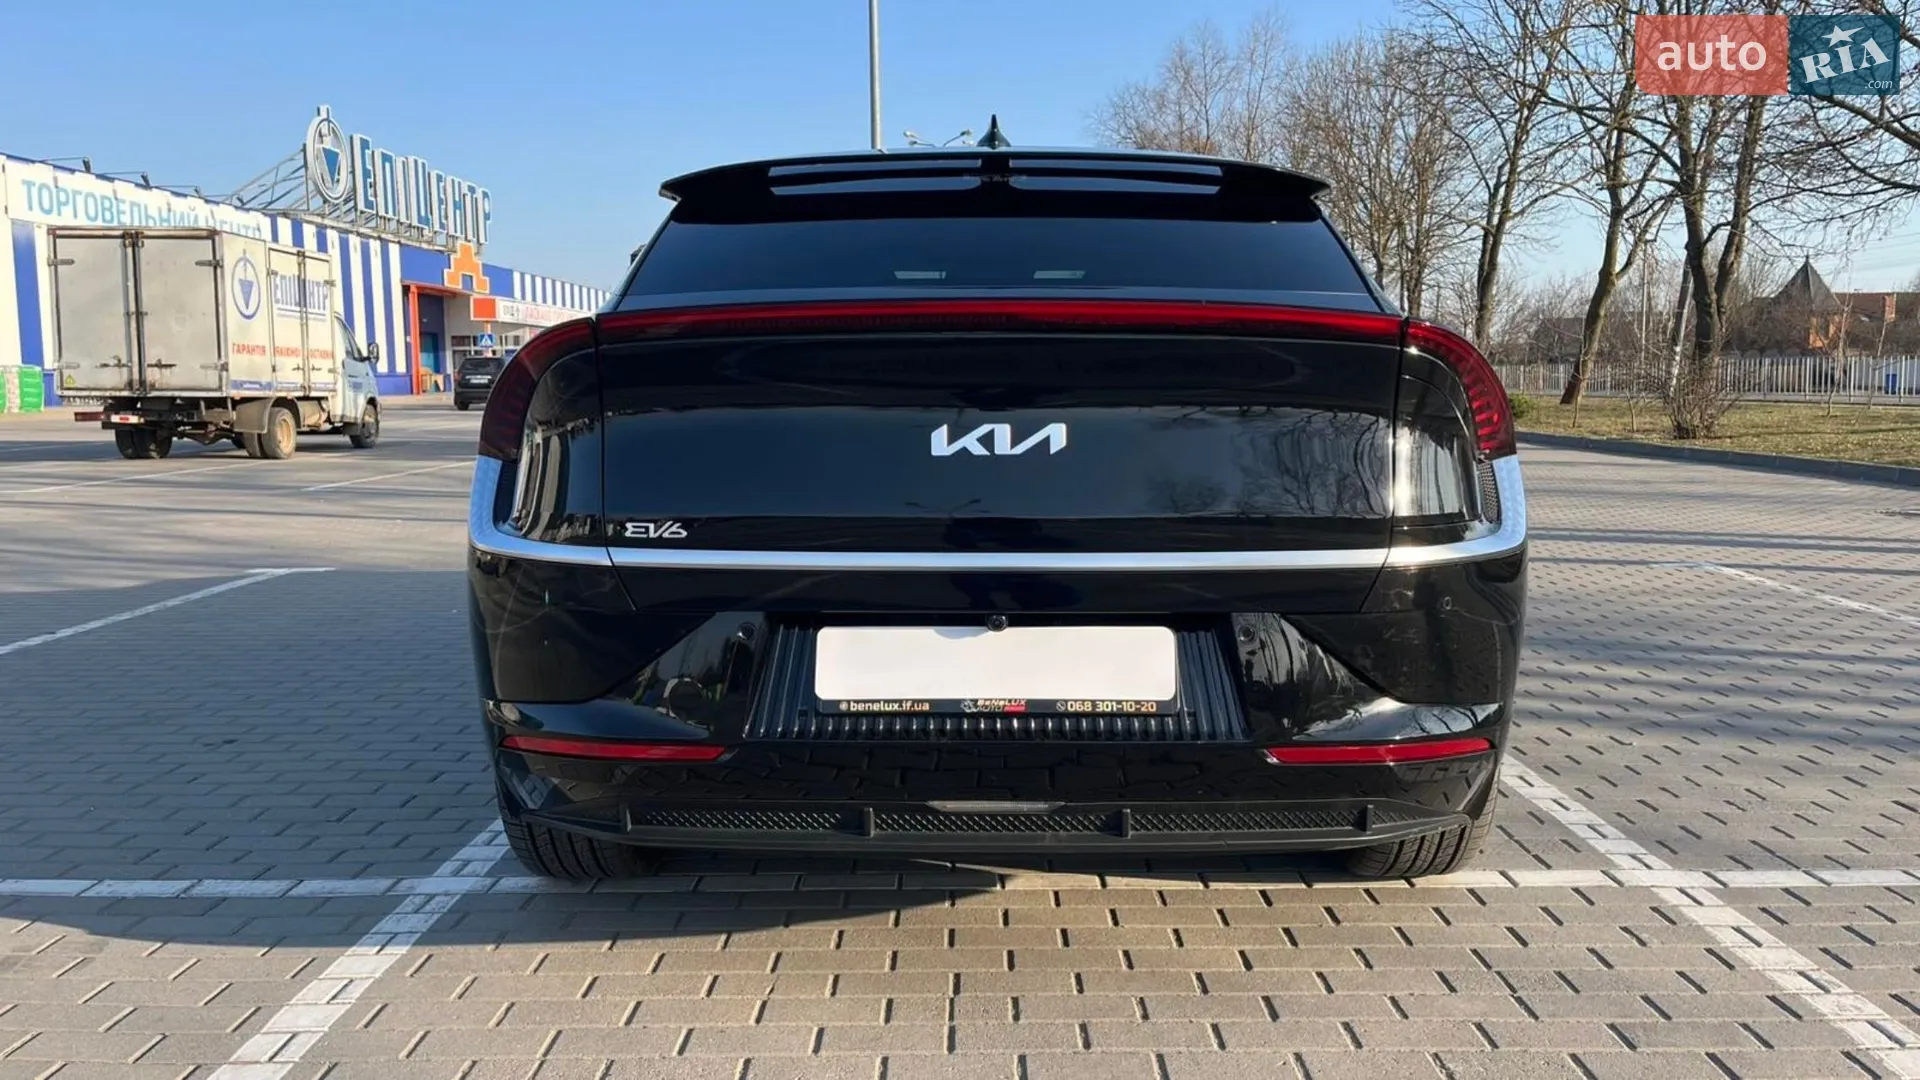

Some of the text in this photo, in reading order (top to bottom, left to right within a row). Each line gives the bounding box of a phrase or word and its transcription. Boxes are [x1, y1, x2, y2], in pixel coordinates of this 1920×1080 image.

[21, 178, 199, 229] ТОРГОВЕЛЬНИЙ
[350, 133, 492, 244] ЕПІЦЕНТР
[931, 423, 1067, 456] KIA
[625, 520, 688, 539] EV6
[1067, 701, 1157, 712] 068 301-10-20
